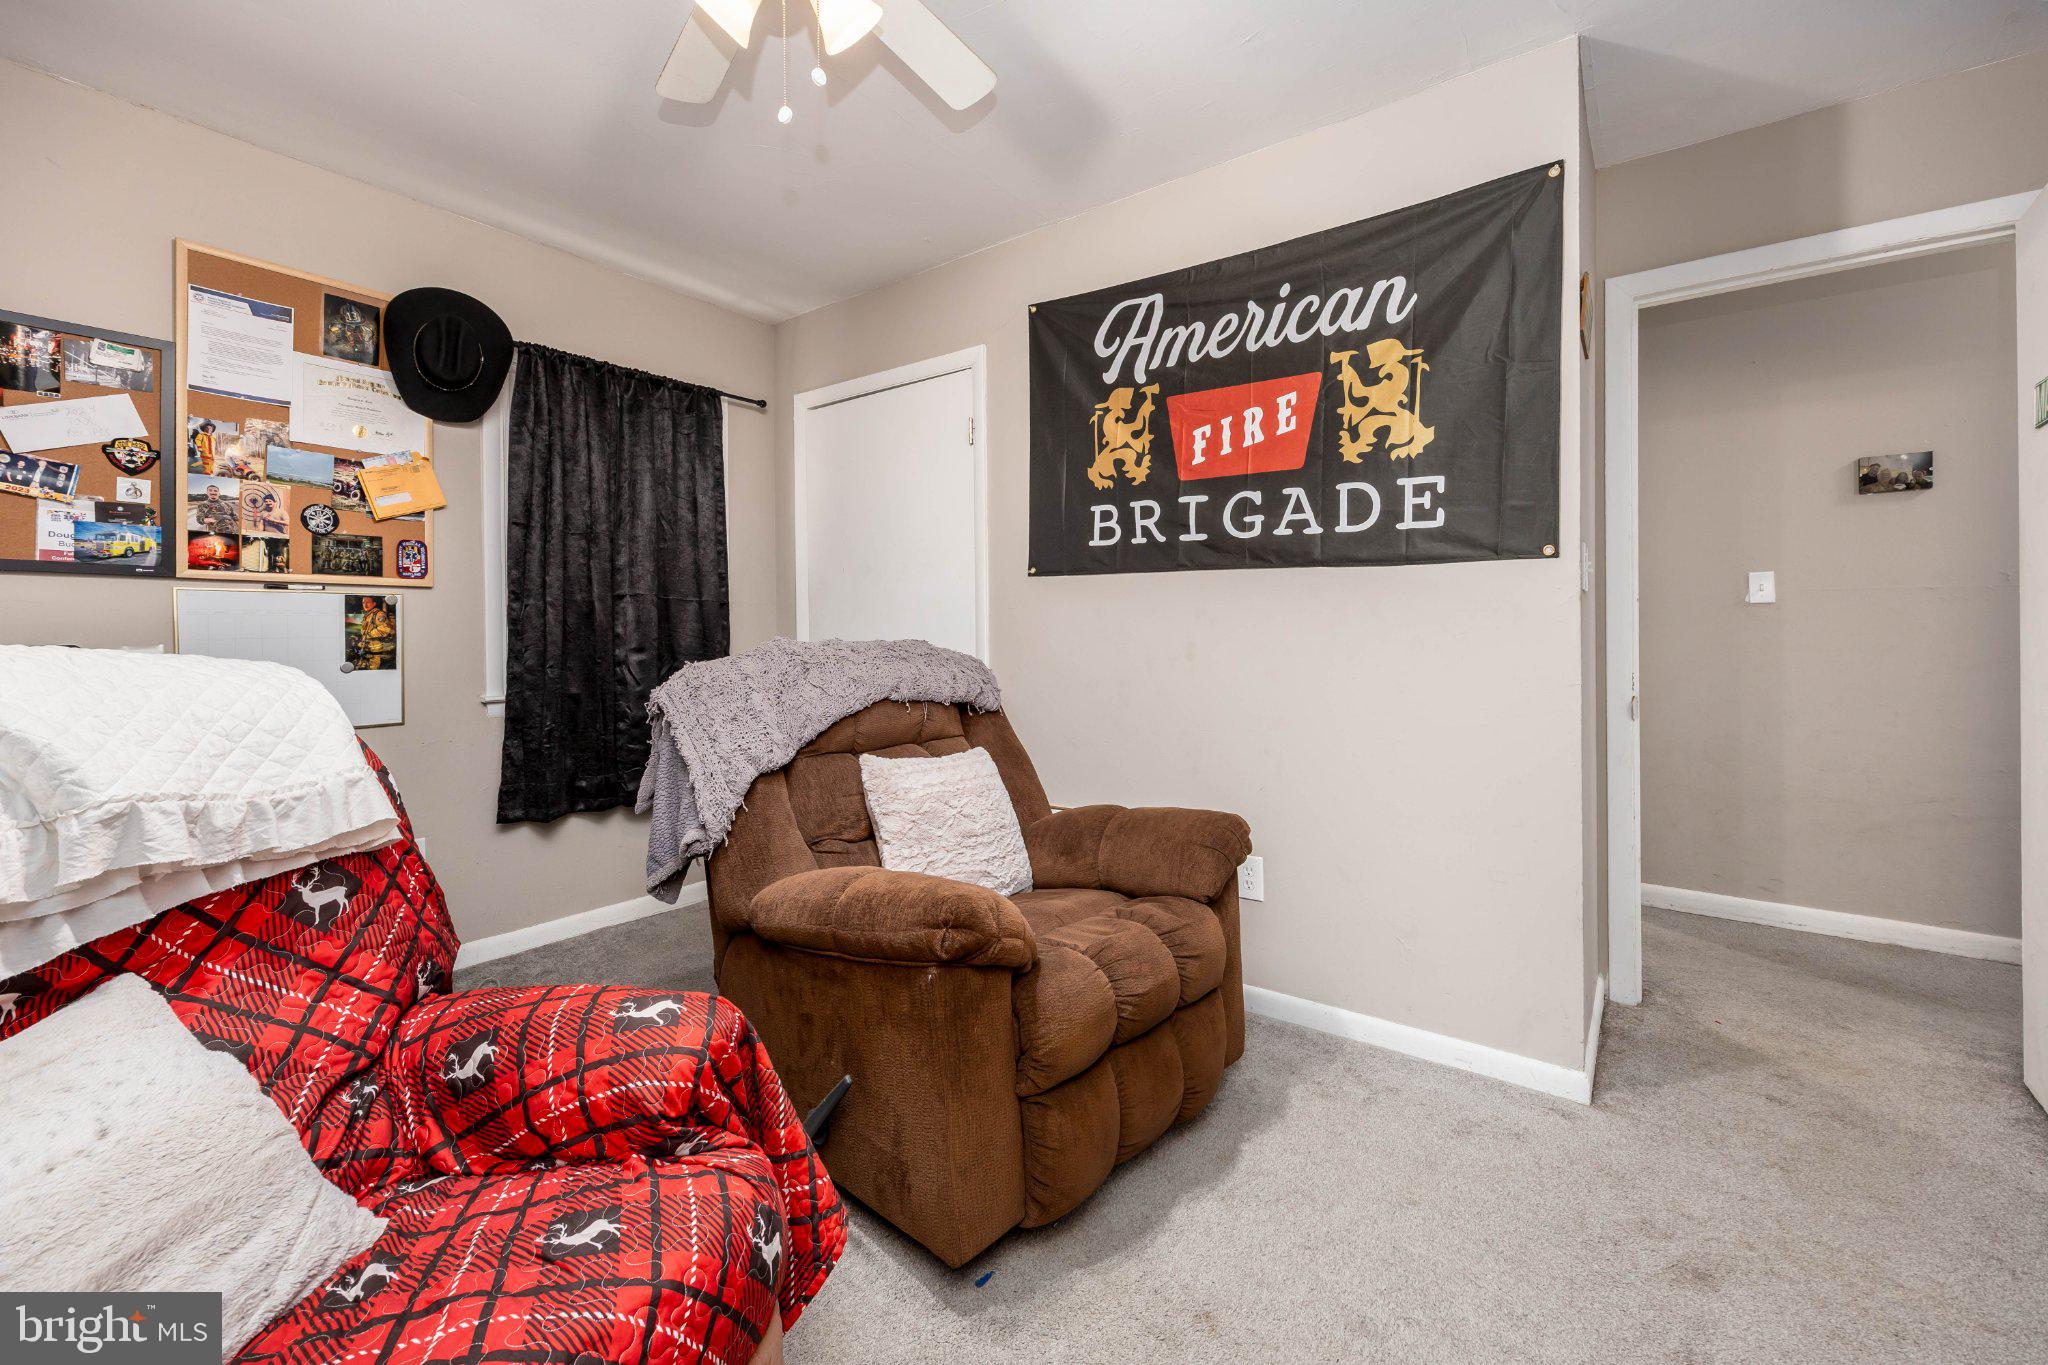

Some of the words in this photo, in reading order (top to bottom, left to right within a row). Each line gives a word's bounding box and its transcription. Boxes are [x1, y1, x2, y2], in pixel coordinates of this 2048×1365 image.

[1094, 275, 1418, 385] American
[1190, 390, 1297, 466] FIRE
[5, 484, 30, 494] 2023
[1088, 475, 1445, 547] BRIGADE
